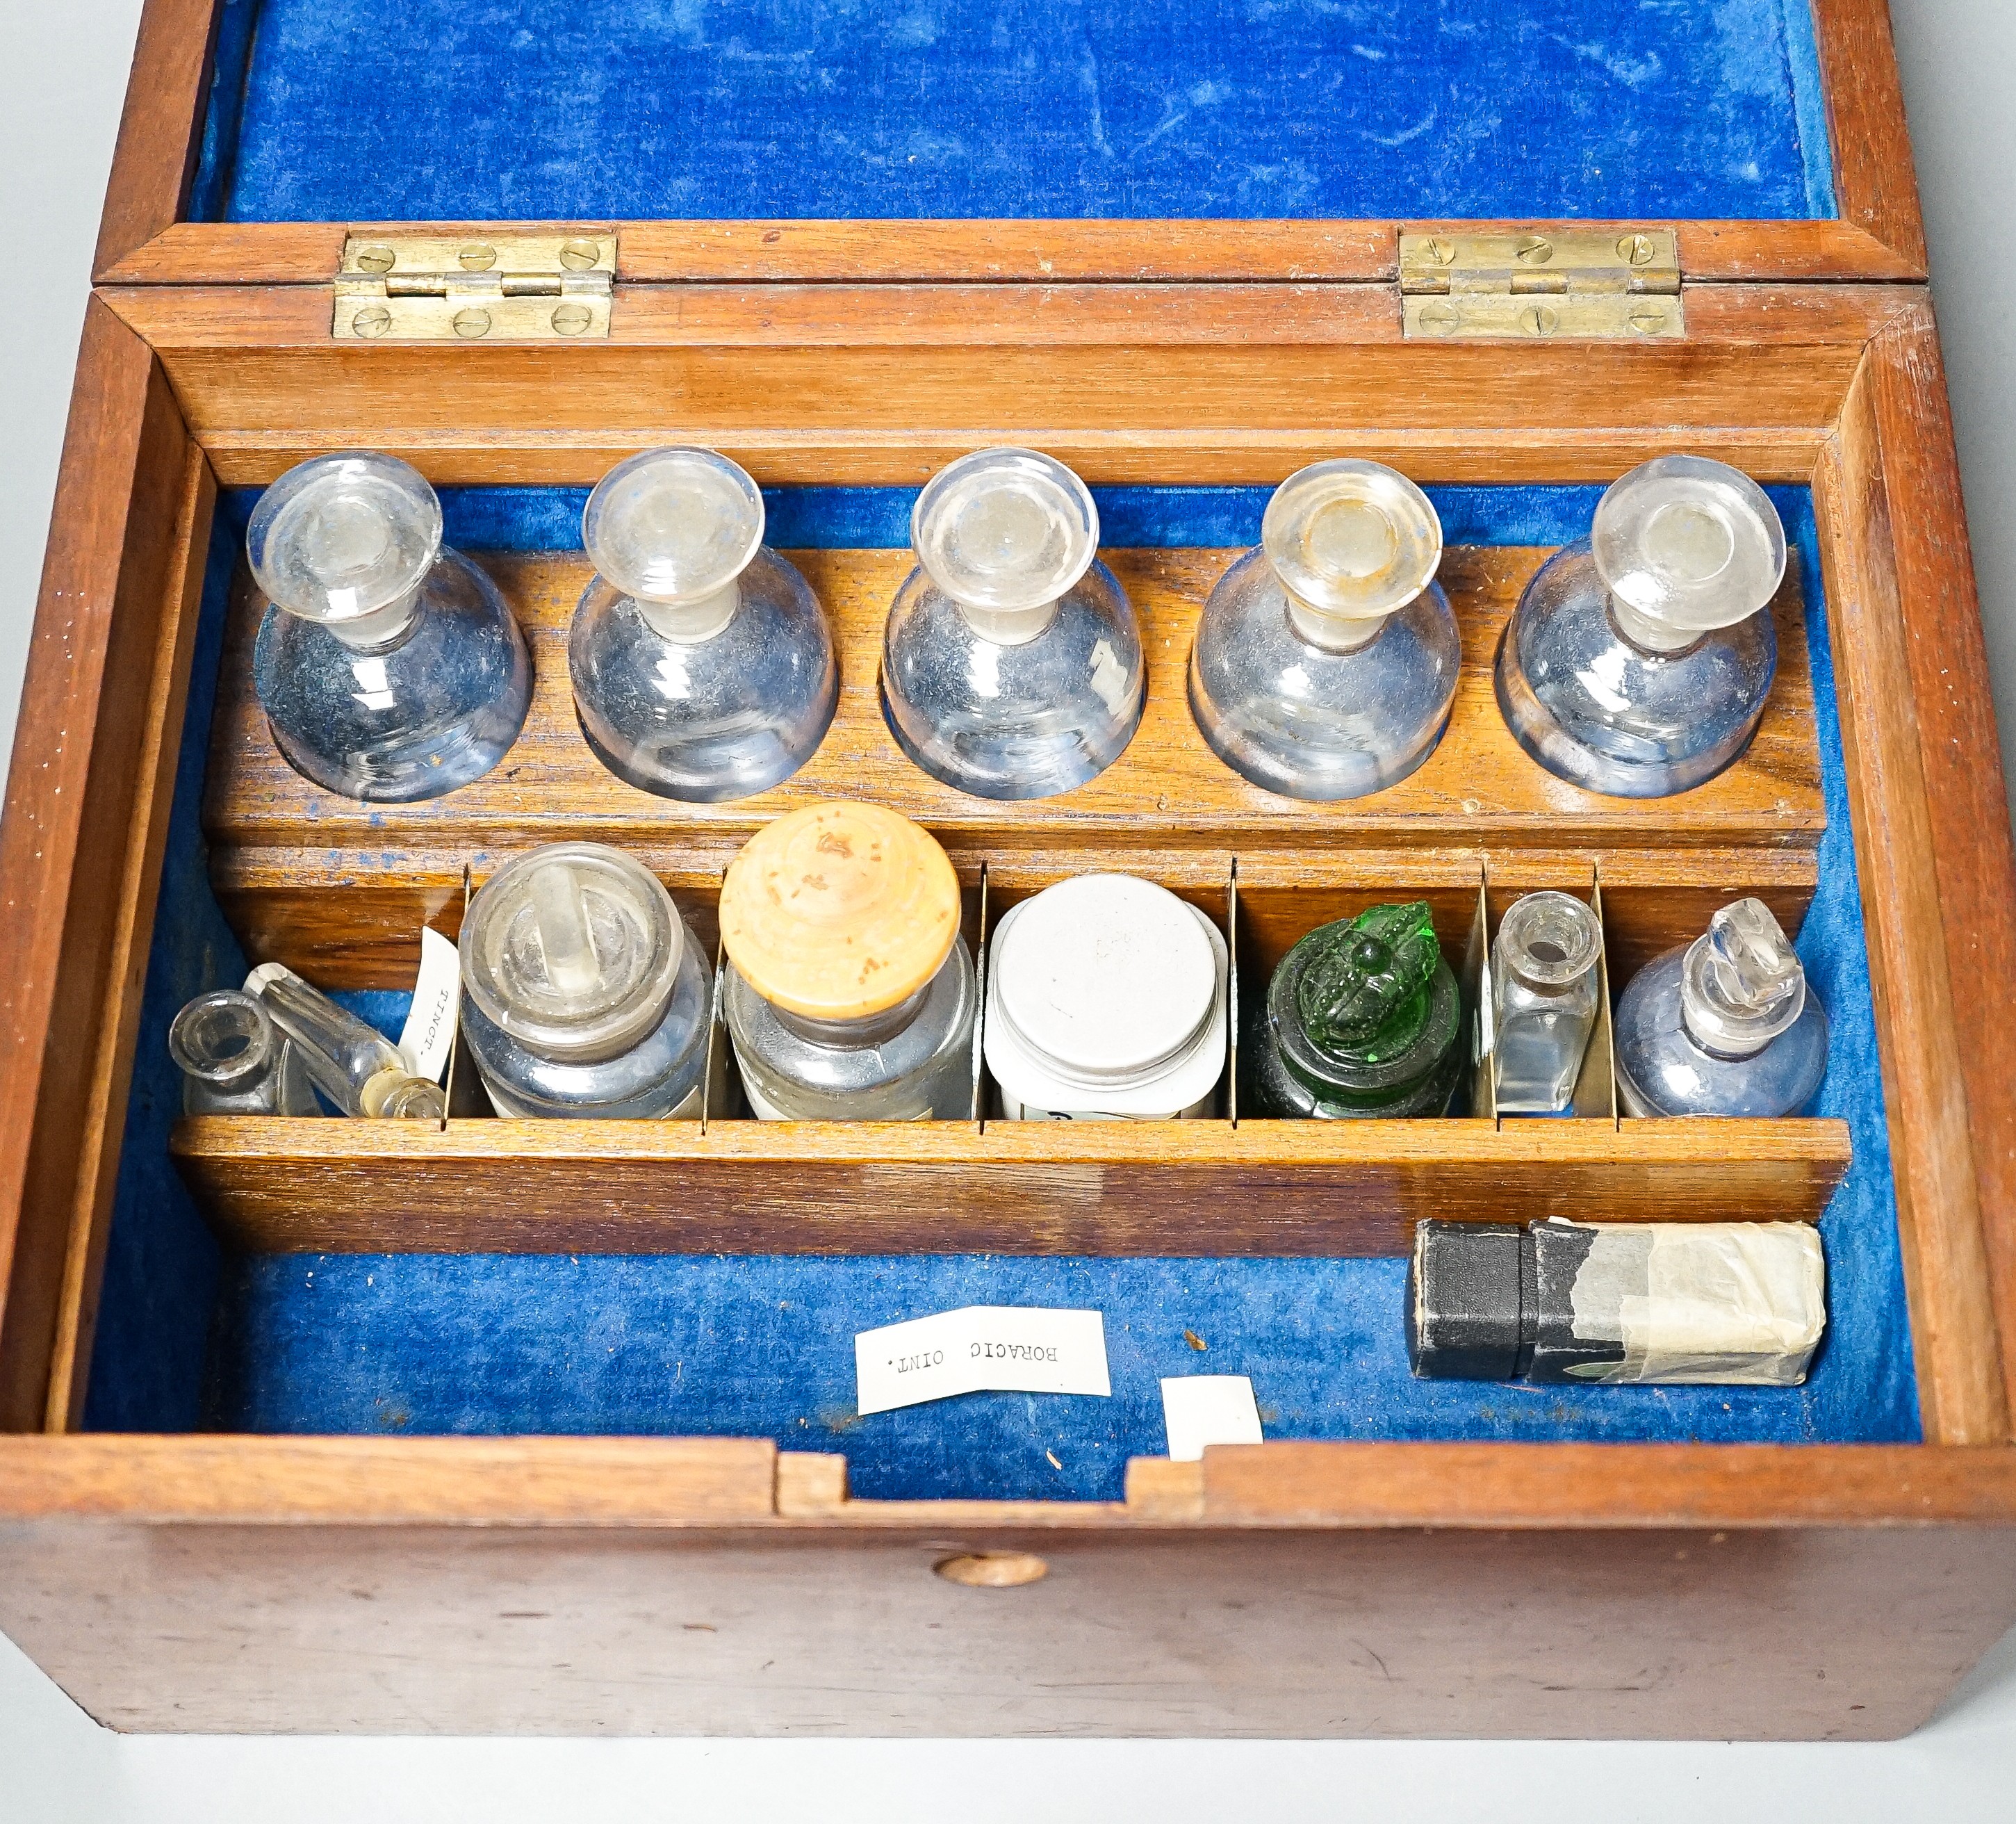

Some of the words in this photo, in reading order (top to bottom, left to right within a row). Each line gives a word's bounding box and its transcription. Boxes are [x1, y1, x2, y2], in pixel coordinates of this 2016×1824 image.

[420, 988, 449, 1056] TINCT.
[887, 1349, 944, 1374] OINT.
[970, 1342, 1058, 1362] BORACIC
